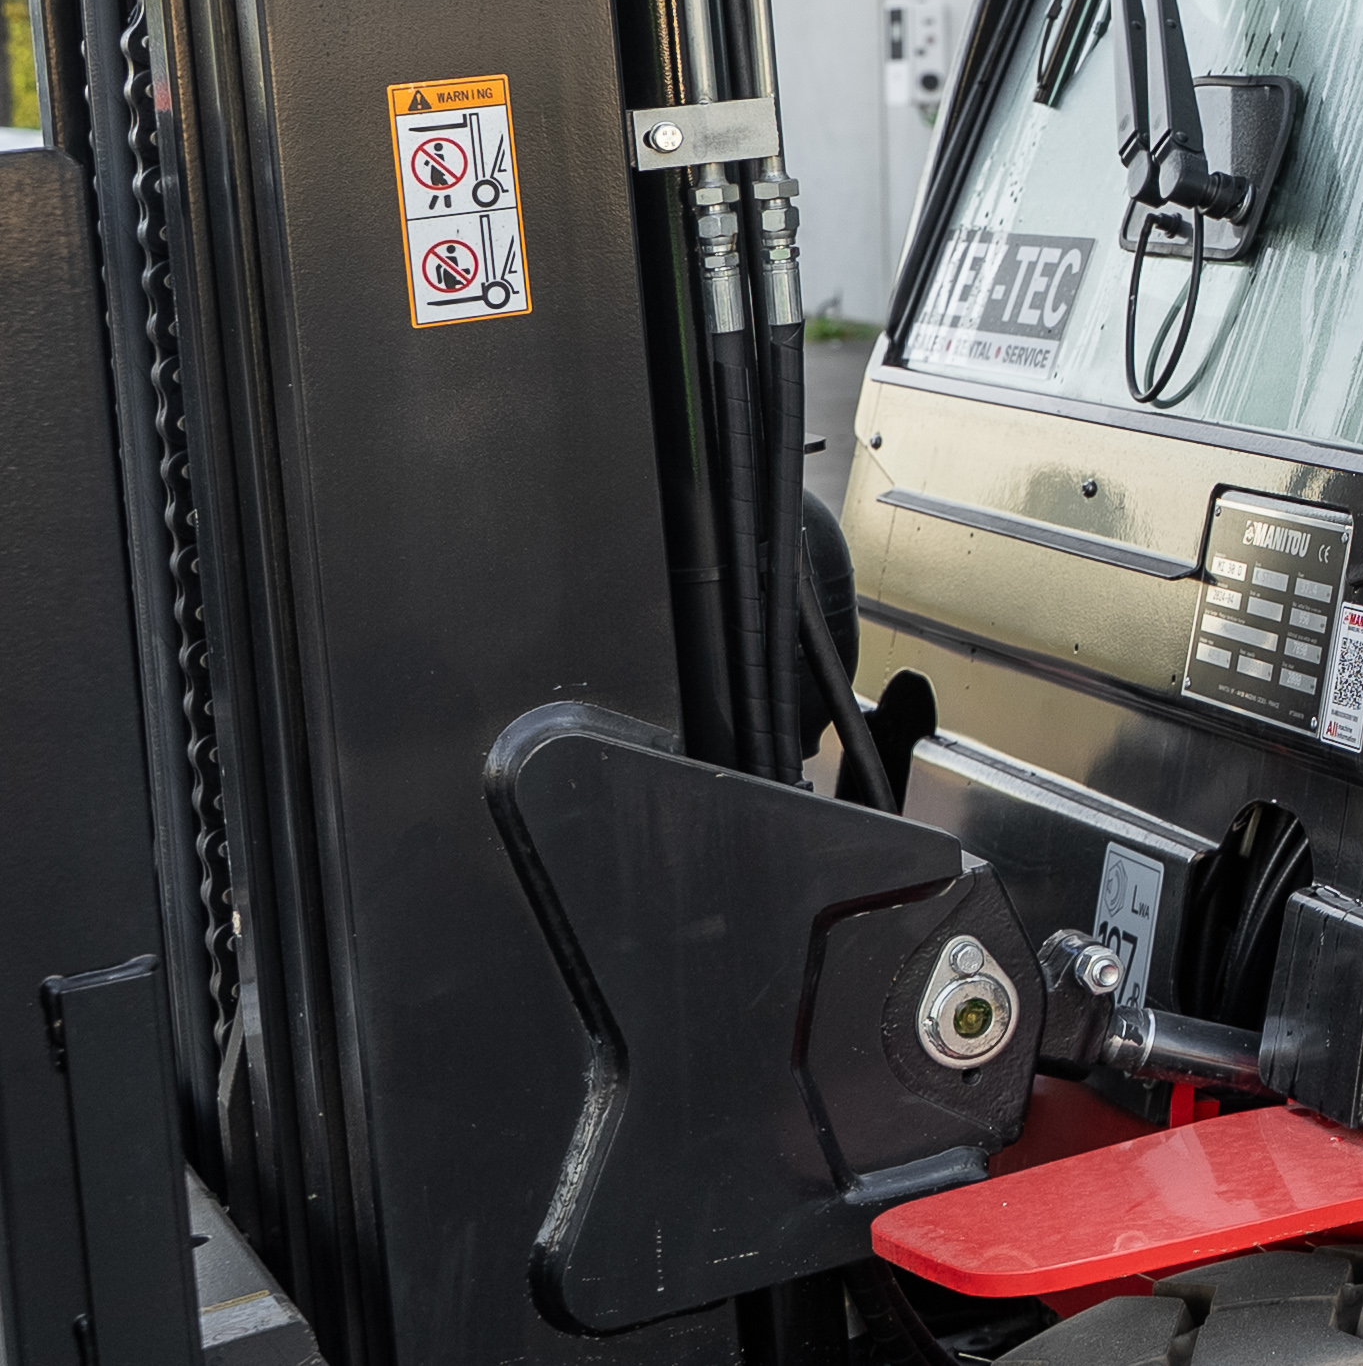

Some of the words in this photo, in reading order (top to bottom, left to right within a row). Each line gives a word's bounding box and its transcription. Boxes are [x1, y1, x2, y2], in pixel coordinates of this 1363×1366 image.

[436, 88, 493, 103] WARNING
[1002, 344, 1051, 369] SERVICE
[1253, 521, 1311, 558] MANITOU
